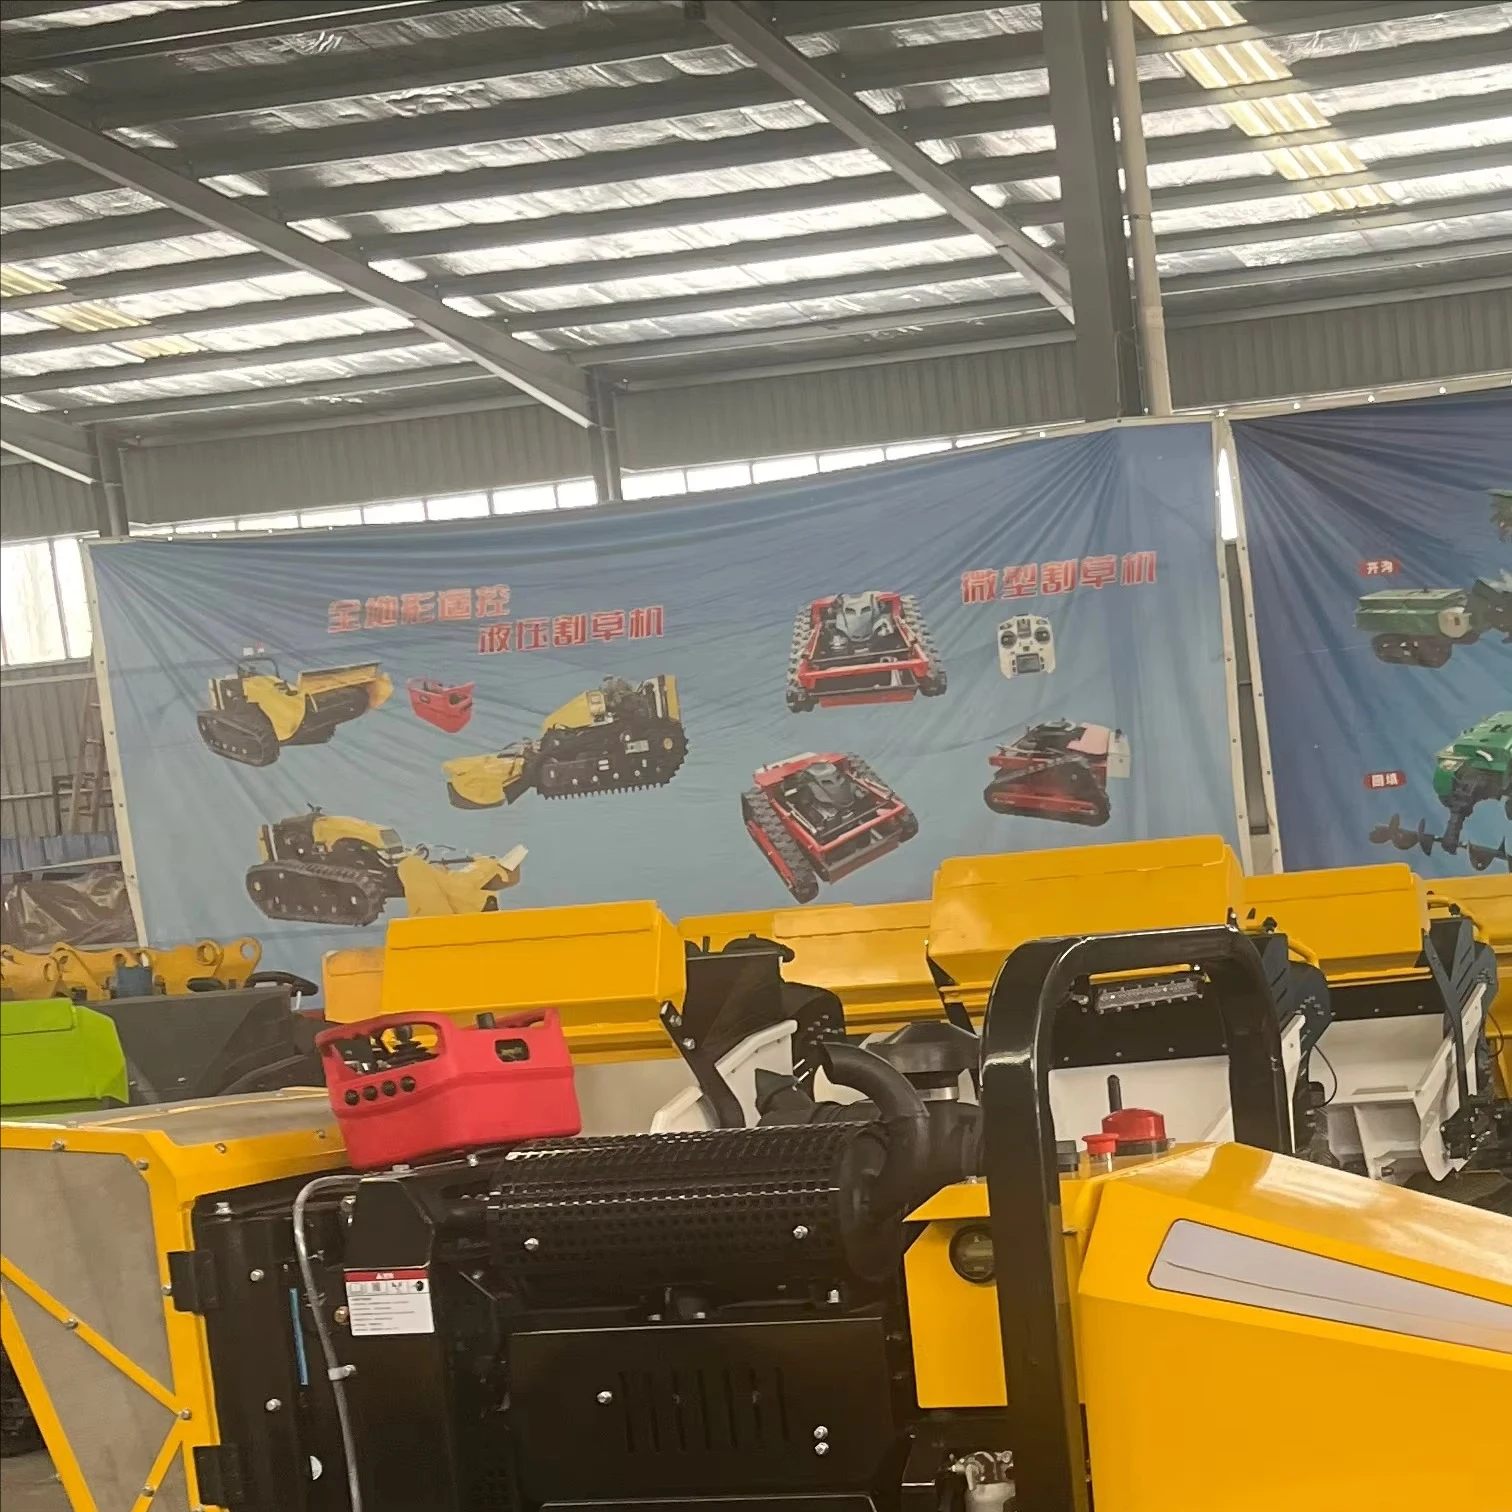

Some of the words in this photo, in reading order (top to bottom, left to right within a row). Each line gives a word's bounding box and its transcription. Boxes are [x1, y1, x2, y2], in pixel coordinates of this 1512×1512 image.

[960, 550, 1158, 604] 微型割草机
[1366, 560, 1393, 574] 开沟
[327, 583, 511, 634] 全地形遥控
[477, 605, 664, 656] 液压割草机
